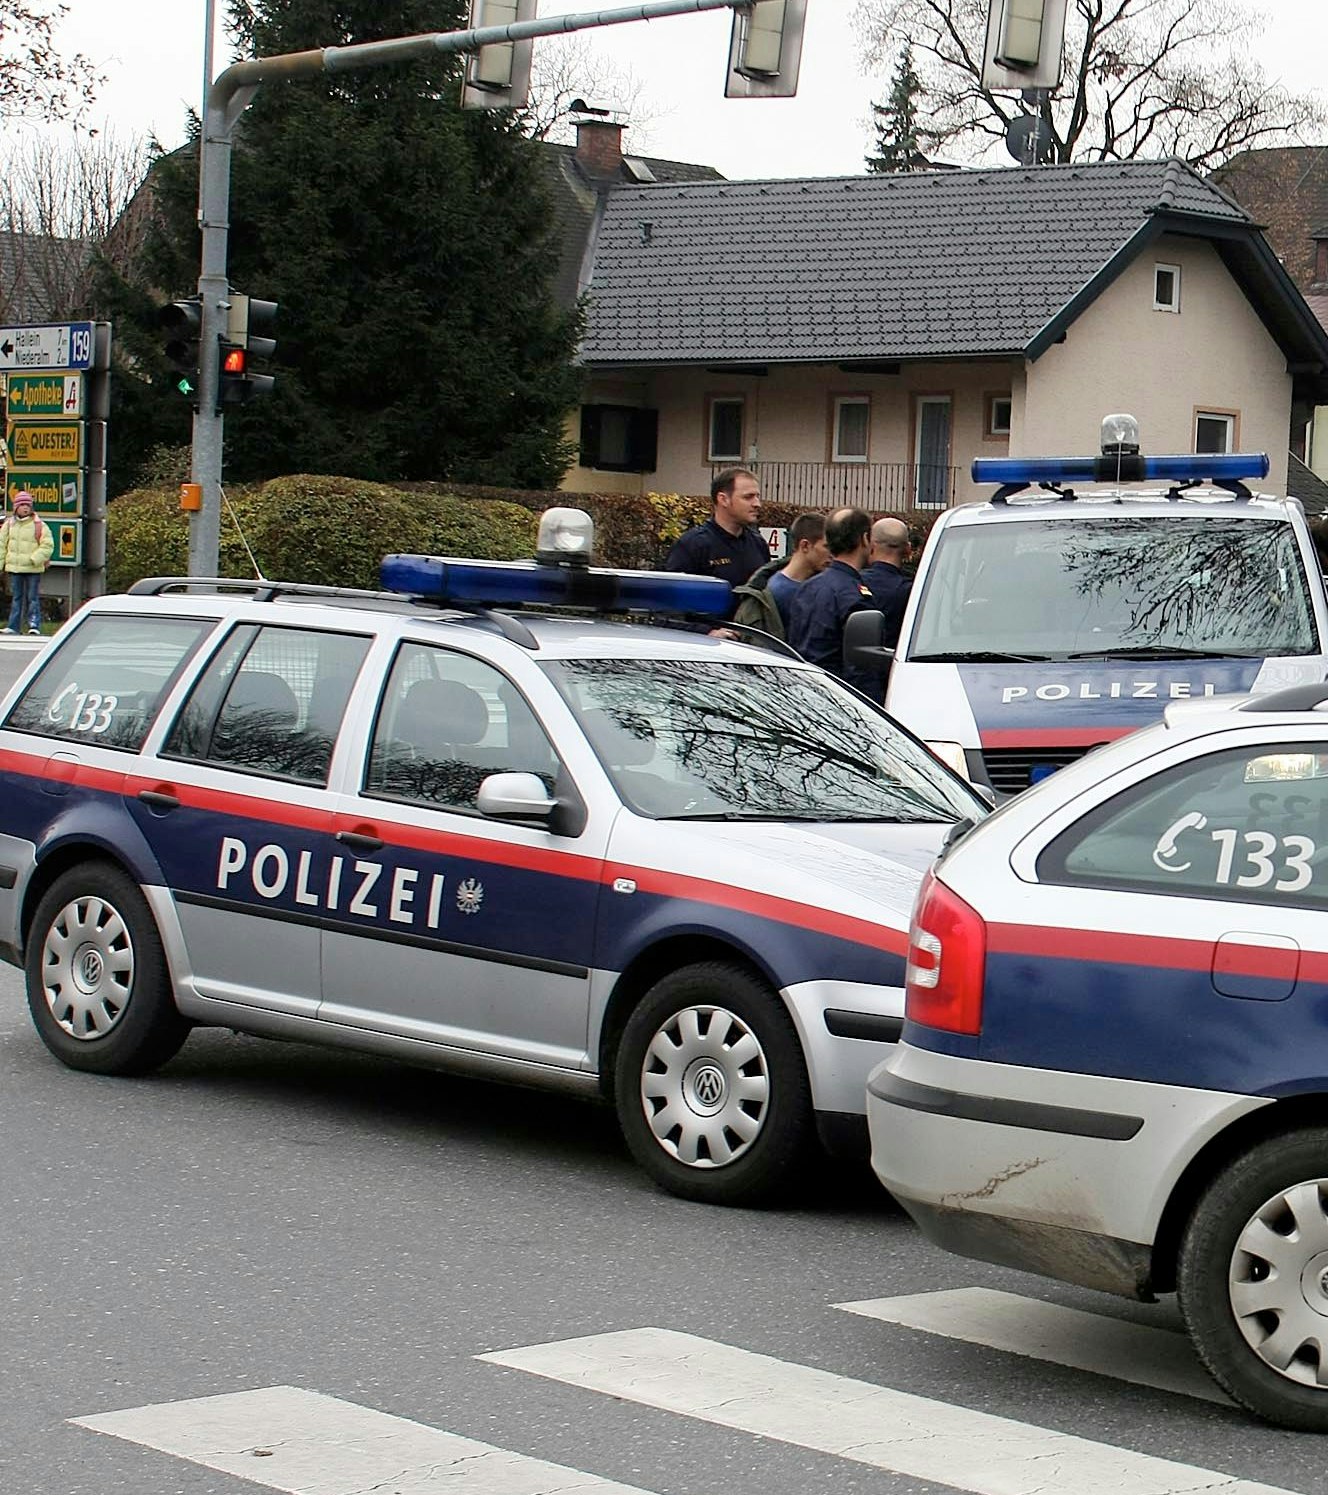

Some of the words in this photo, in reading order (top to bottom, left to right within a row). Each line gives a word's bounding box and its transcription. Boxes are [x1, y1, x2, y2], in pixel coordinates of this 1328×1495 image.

[15, 330, 41, 347] Hallein
[57, 329, 63, 346] 7
[72, 330, 90, 361] 159
[23, 381, 63, 411] Apotheke
[31, 432, 76, 450] QUESTER!
[1001, 682, 1215, 704] POLIZEI
[69, 693, 118, 733] 133
[1211, 828, 1316, 892] 133
[217, 836, 445, 929] POLIZEI
